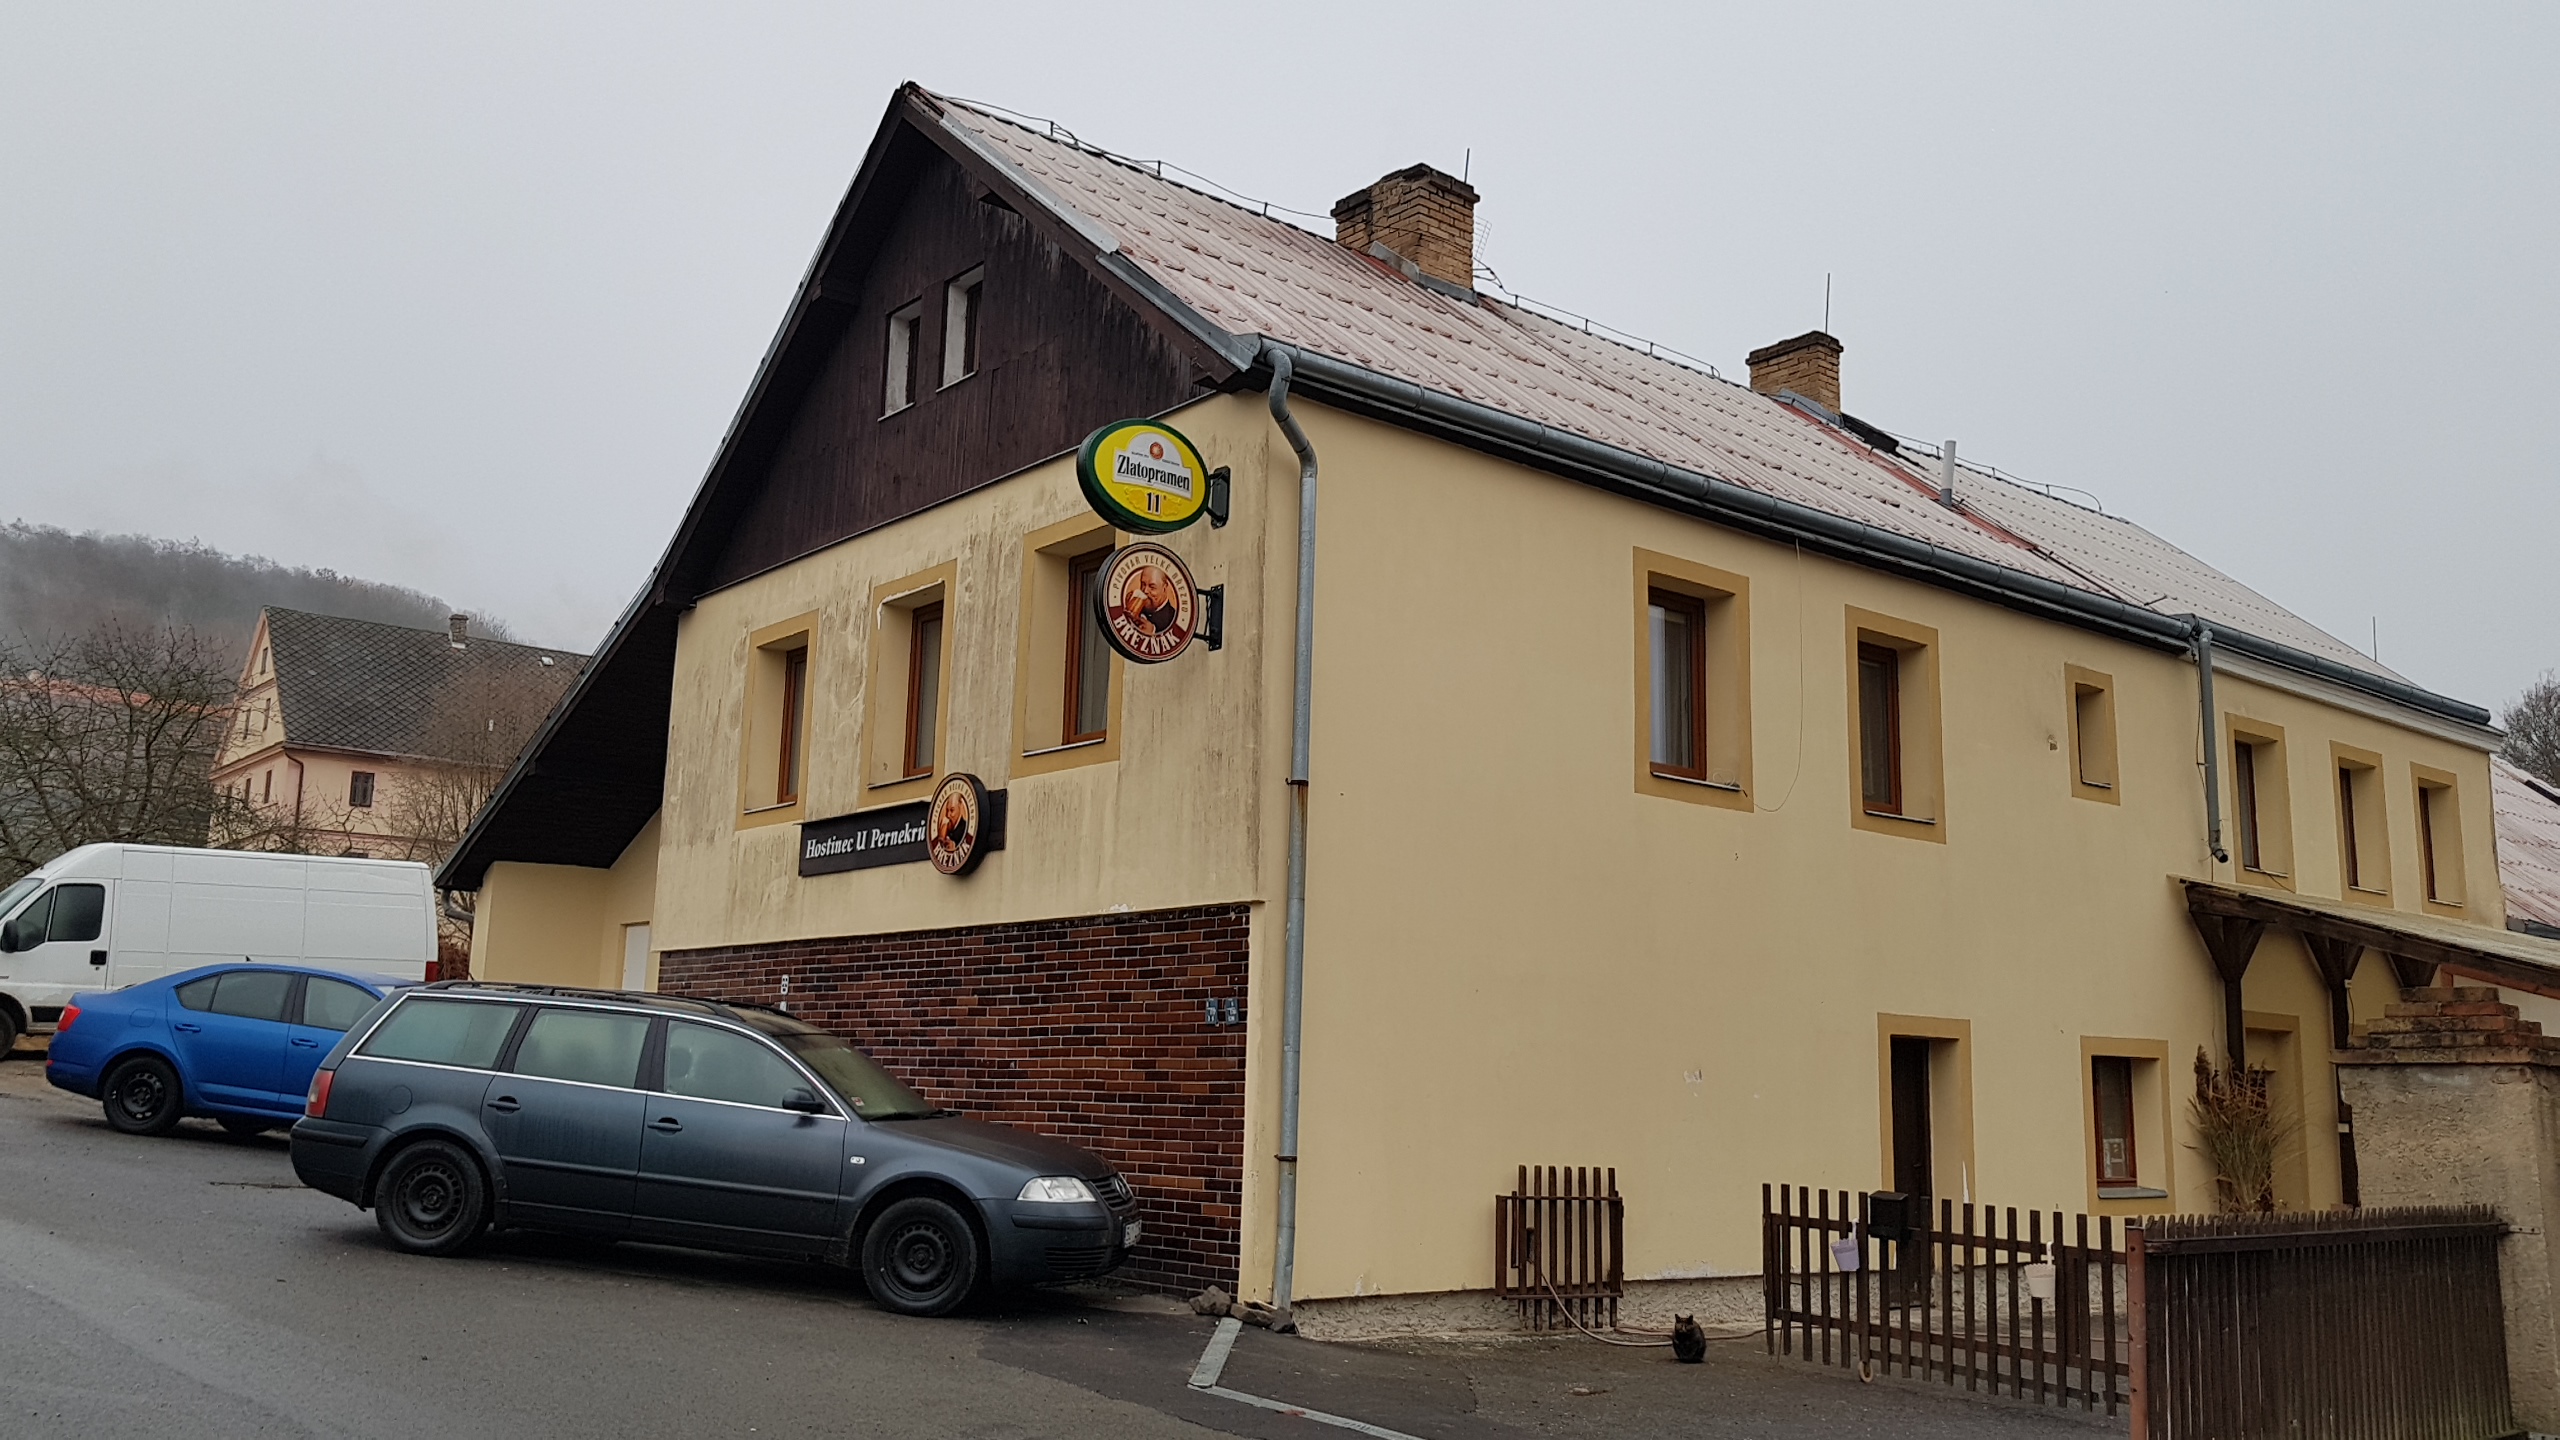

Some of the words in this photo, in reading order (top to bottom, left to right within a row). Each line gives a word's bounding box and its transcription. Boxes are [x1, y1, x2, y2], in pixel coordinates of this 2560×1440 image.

[1117, 454, 1190, 491] Zlatopramen
[1112, 556, 1142, 590] PIVOVAR
[805, 835, 854, 858] Hostinec
[856, 830, 868, 851] U
